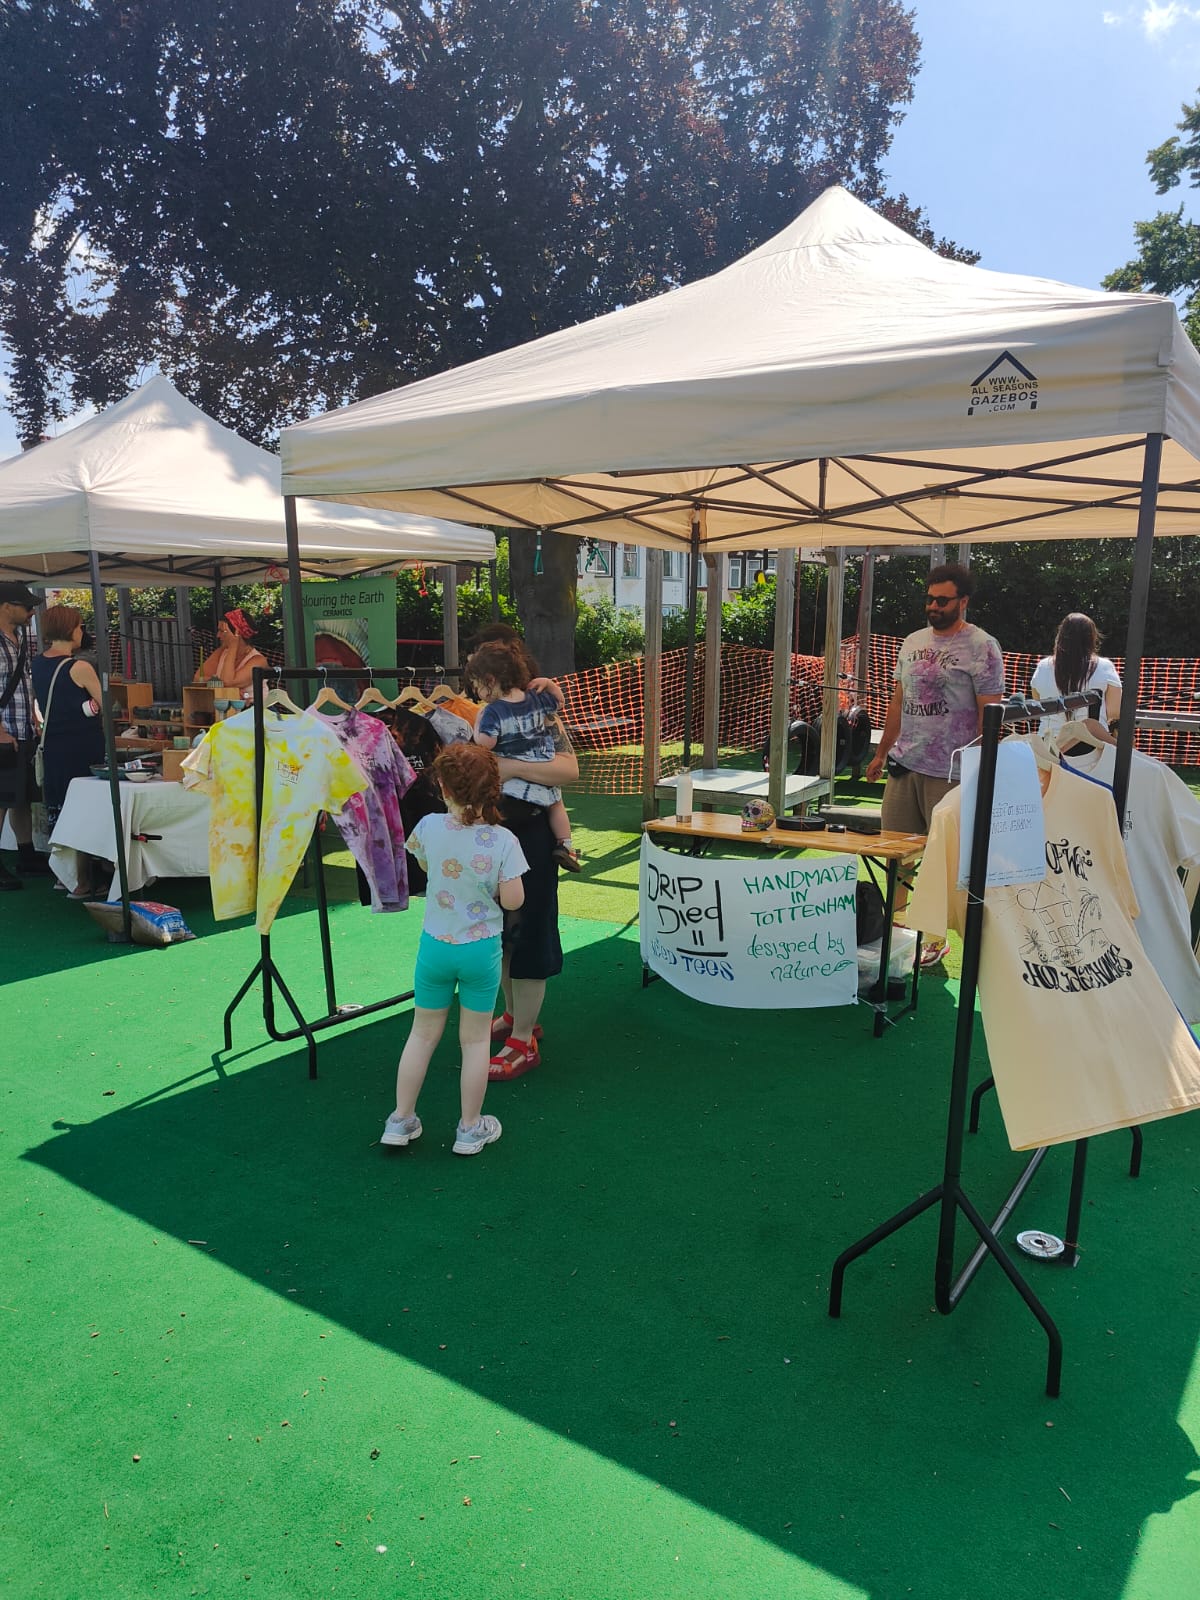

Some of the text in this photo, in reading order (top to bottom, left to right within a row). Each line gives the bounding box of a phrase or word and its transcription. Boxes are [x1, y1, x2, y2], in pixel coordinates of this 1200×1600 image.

[993, 381, 1038, 392] SEASONS
[971, 391, 1037, 405] GAZEBOS
[989, 404, 1015, 412] .COM
[341, 593, 356, 605] the
[358, 590, 384, 605] Earth
[323, 609, 352, 617] CERAMICS
[743, 866, 856, 894] HANDMADE
[791, 889, 808, 903] IN
[750, 894, 856, 927] TOTTENHAM
[747, 932, 845, 960] designed by
[770, 961, 836, 982] nature
